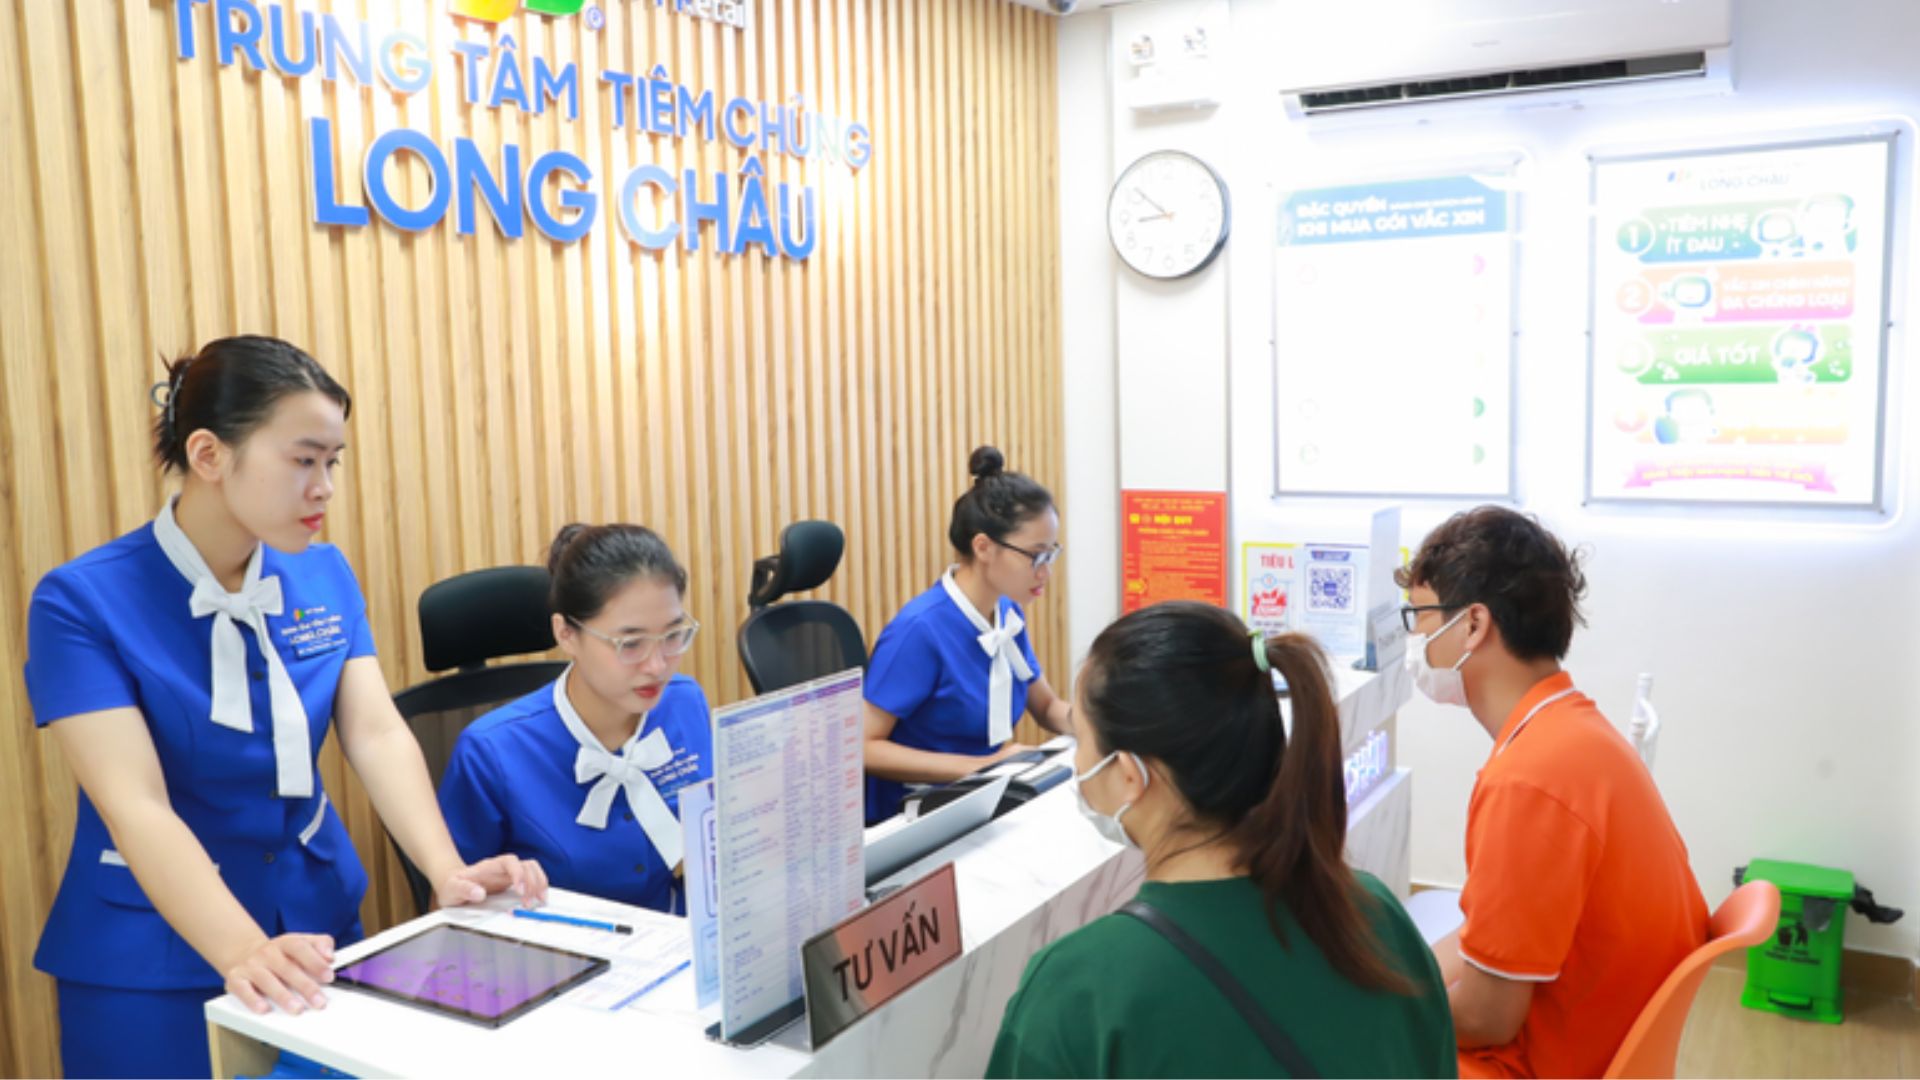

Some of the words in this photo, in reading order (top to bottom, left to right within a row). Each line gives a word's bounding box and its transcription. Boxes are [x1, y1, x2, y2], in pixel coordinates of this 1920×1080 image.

[173, 0, 432, 93] TRUNG
[454, 34, 578, 119] TÂM
[602, 64, 714, 141] TIÊM
[309, 117, 598, 242] LONG
[619, 155, 817, 259] CHÂU
[1331, 218, 1371, 234] MUA
[1375, 212, 1408, 231] GÓI
[1674, 345, 1711, 366] GIÁ
[1718, 339, 1761, 365] TỐT
[833, 939, 875, 1002] TƯ
[879, 901, 941, 973] VẤN
